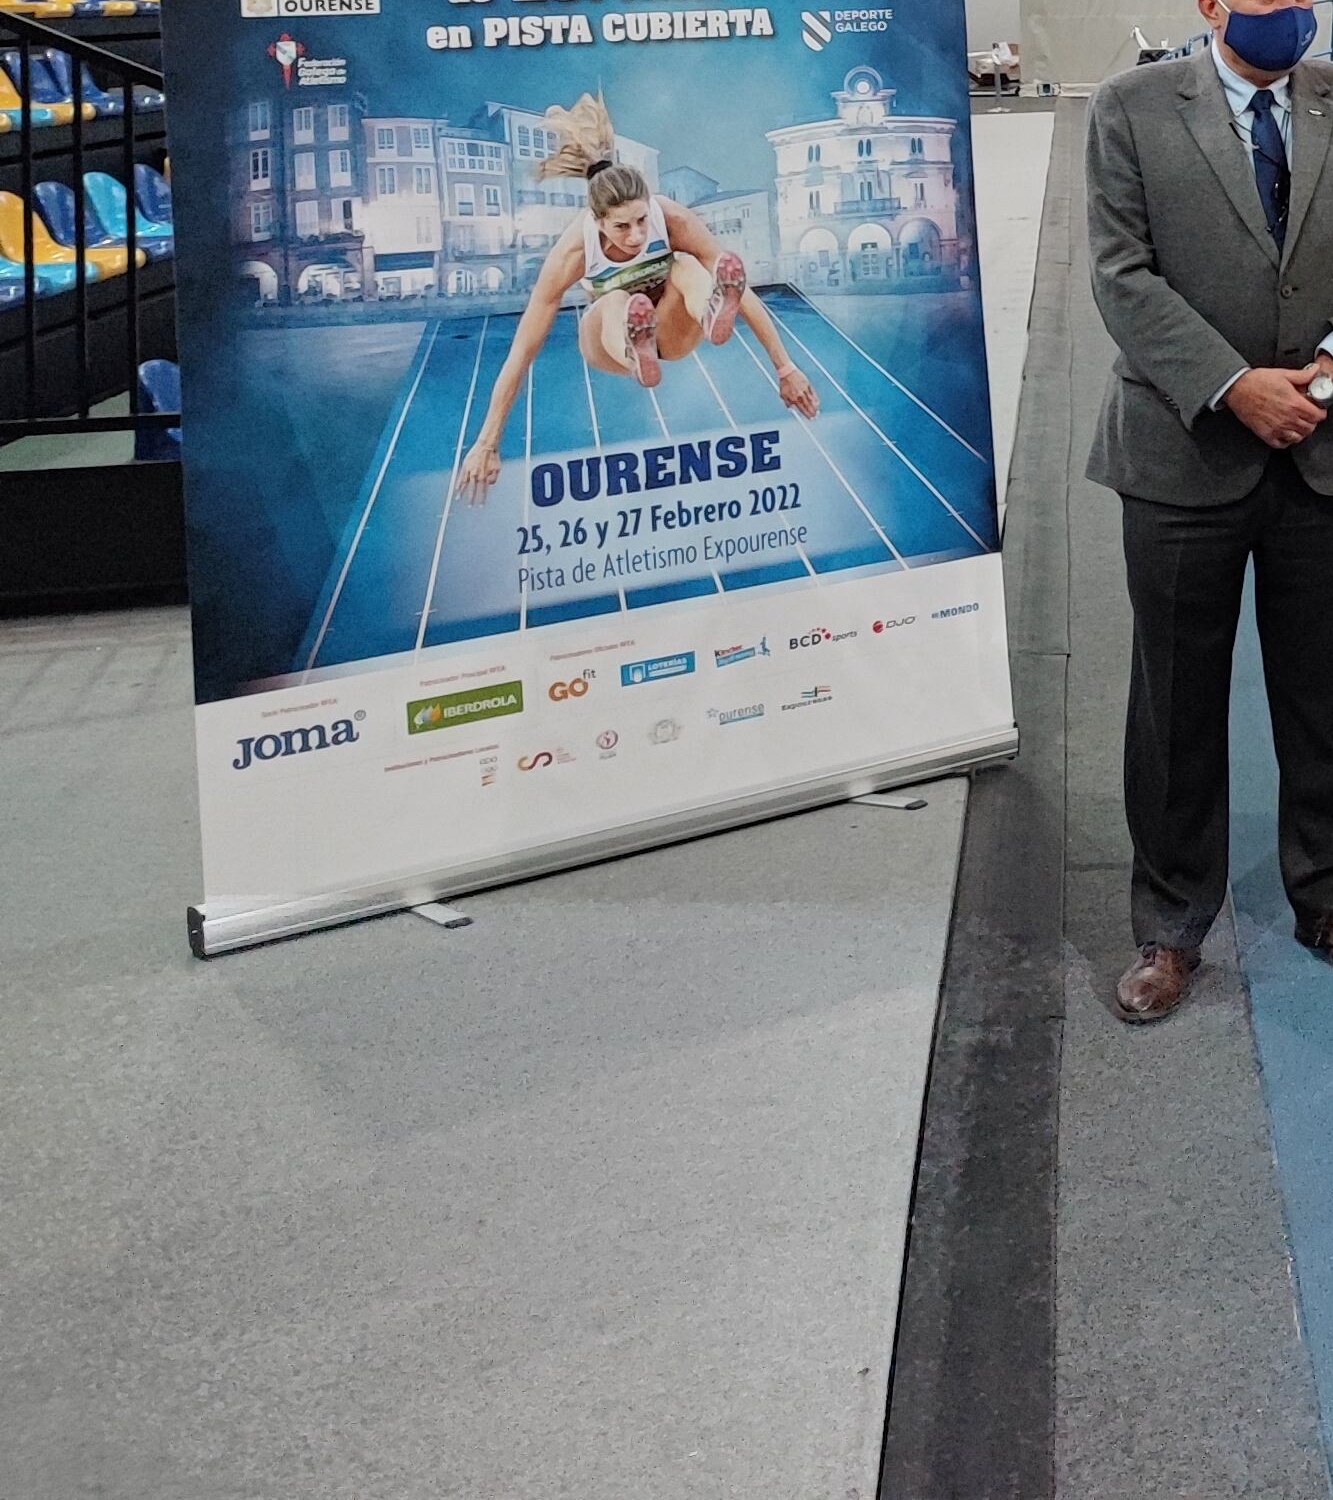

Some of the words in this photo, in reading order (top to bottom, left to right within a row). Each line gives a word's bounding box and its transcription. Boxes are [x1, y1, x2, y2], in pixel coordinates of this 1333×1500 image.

[835, 9, 892, 20] DEPORTE
[835, 21, 887, 32] GALEGO
[426, 25, 472, 49] en
[483, 15, 593, 46] PISTA
[602, 8, 773, 42] CUBIERTA
[531, 430, 781, 507] OURENSE
[517, 524, 551, 555] 25,
[559, 518, 587, 548] 26
[595, 521, 609, 548] y
[617, 508, 642, 538] 27
[651, 499, 742, 532] Febrero
[749, 483, 801, 516] 2022
[518, 567, 565, 593] Pista
[572, 558, 596, 584] de
[603, 544, 697, 578] Atletismo
[704, 526, 808, 563] Expourense
[885, 616, 916, 629] DJO
[939, 602, 980, 620] MONDO
[789, 633, 822, 650] BCD
[549, 677, 589, 701] GO
[583, 669, 597, 680] fit
[443, 694, 519, 719] IBERDROLA
